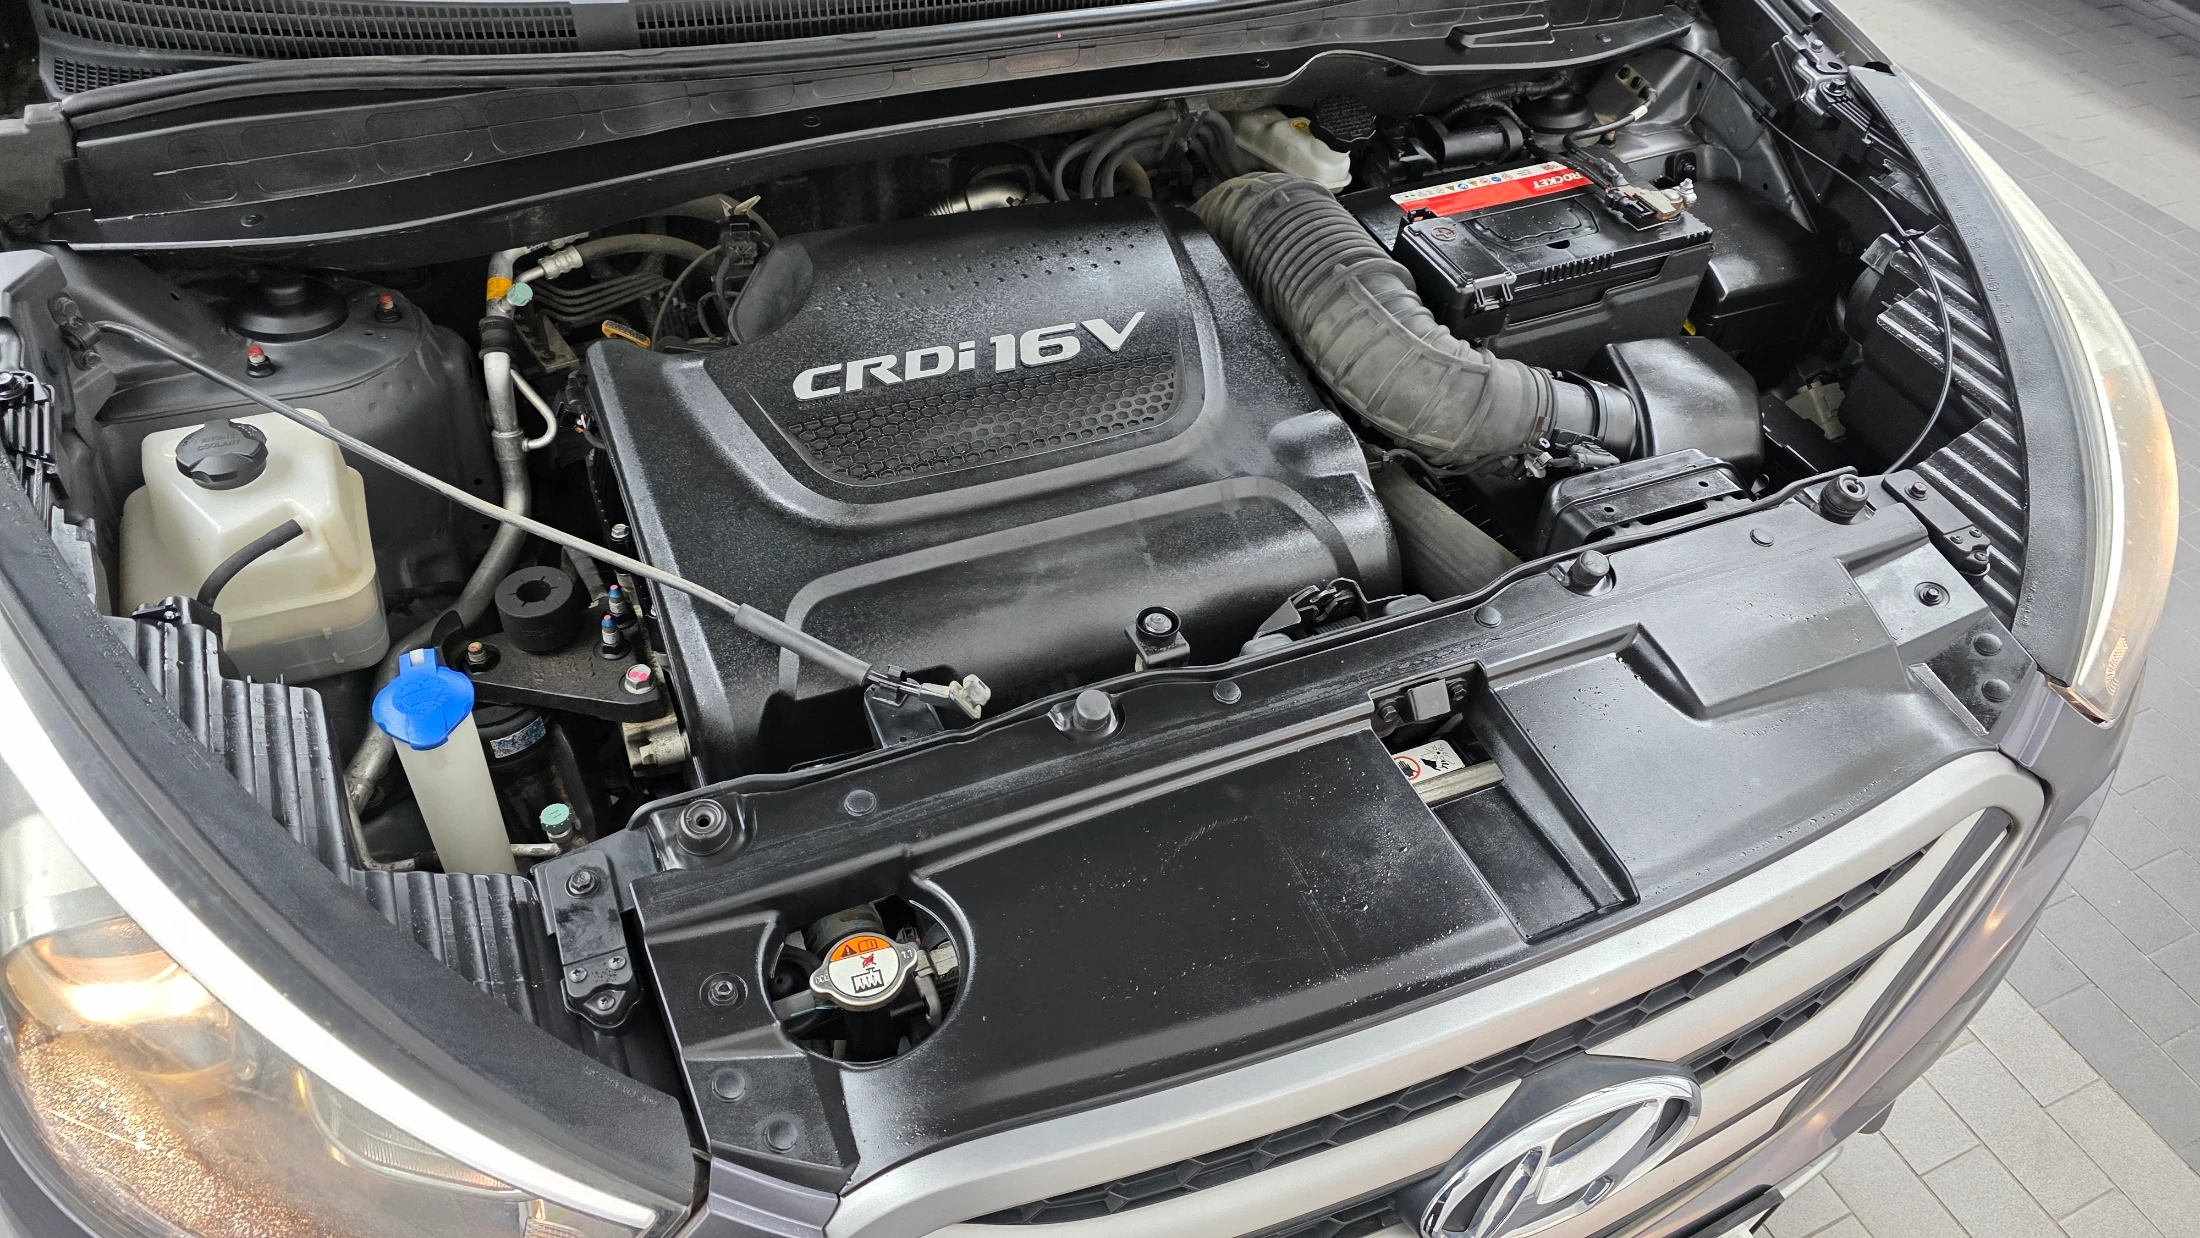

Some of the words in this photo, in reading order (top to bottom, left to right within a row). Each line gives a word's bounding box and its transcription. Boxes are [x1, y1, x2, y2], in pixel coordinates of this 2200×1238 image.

[1532, 172, 1582, 190] ROCKET
[792, 340, 976, 401] CRDi
[989, 311, 1146, 374] 16V
